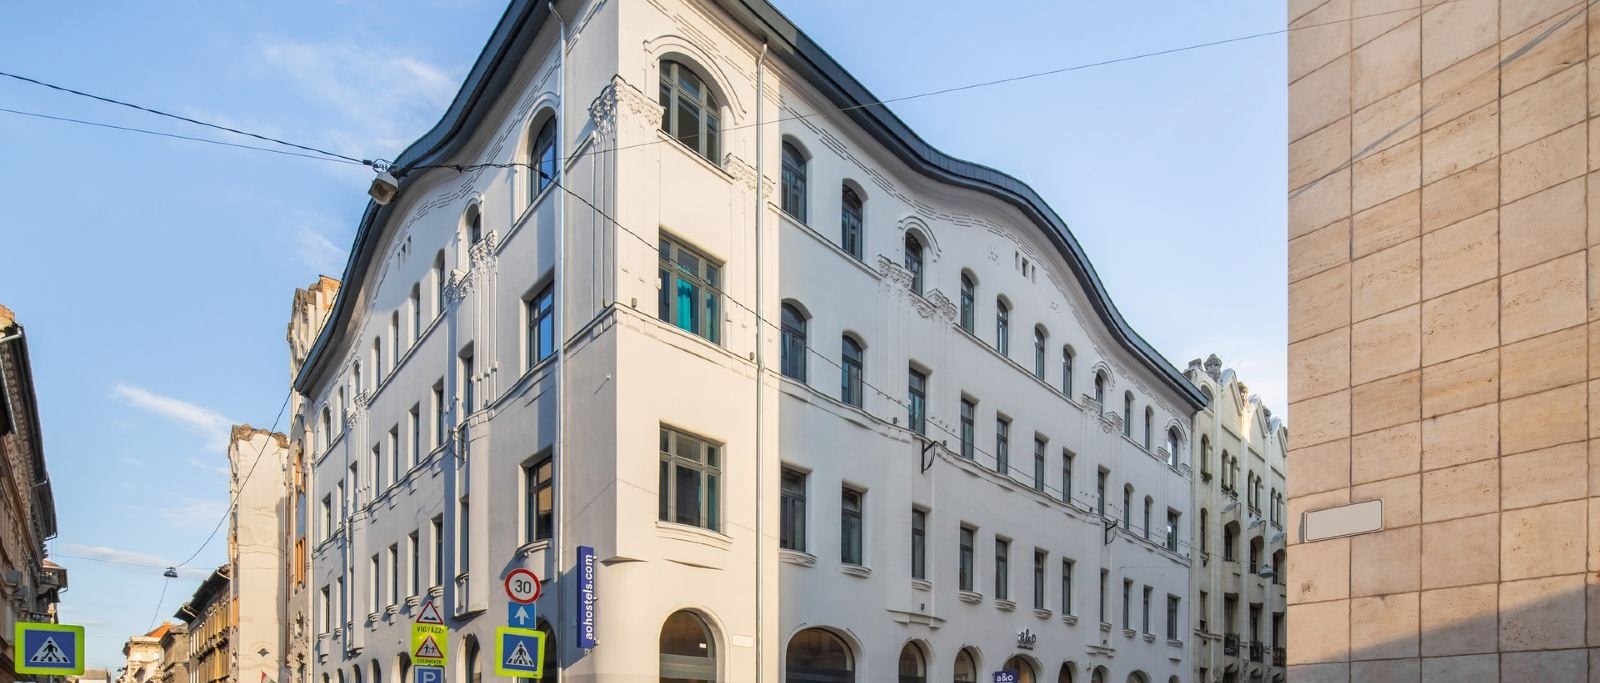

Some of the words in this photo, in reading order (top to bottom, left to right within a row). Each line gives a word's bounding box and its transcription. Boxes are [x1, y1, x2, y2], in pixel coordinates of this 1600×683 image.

[514, 579, 532, 594] 30
[583, 554, 592, 640] aohostels.com
[423, 672, 436, 683] P
[996, 672, 1014, 682] a&o
